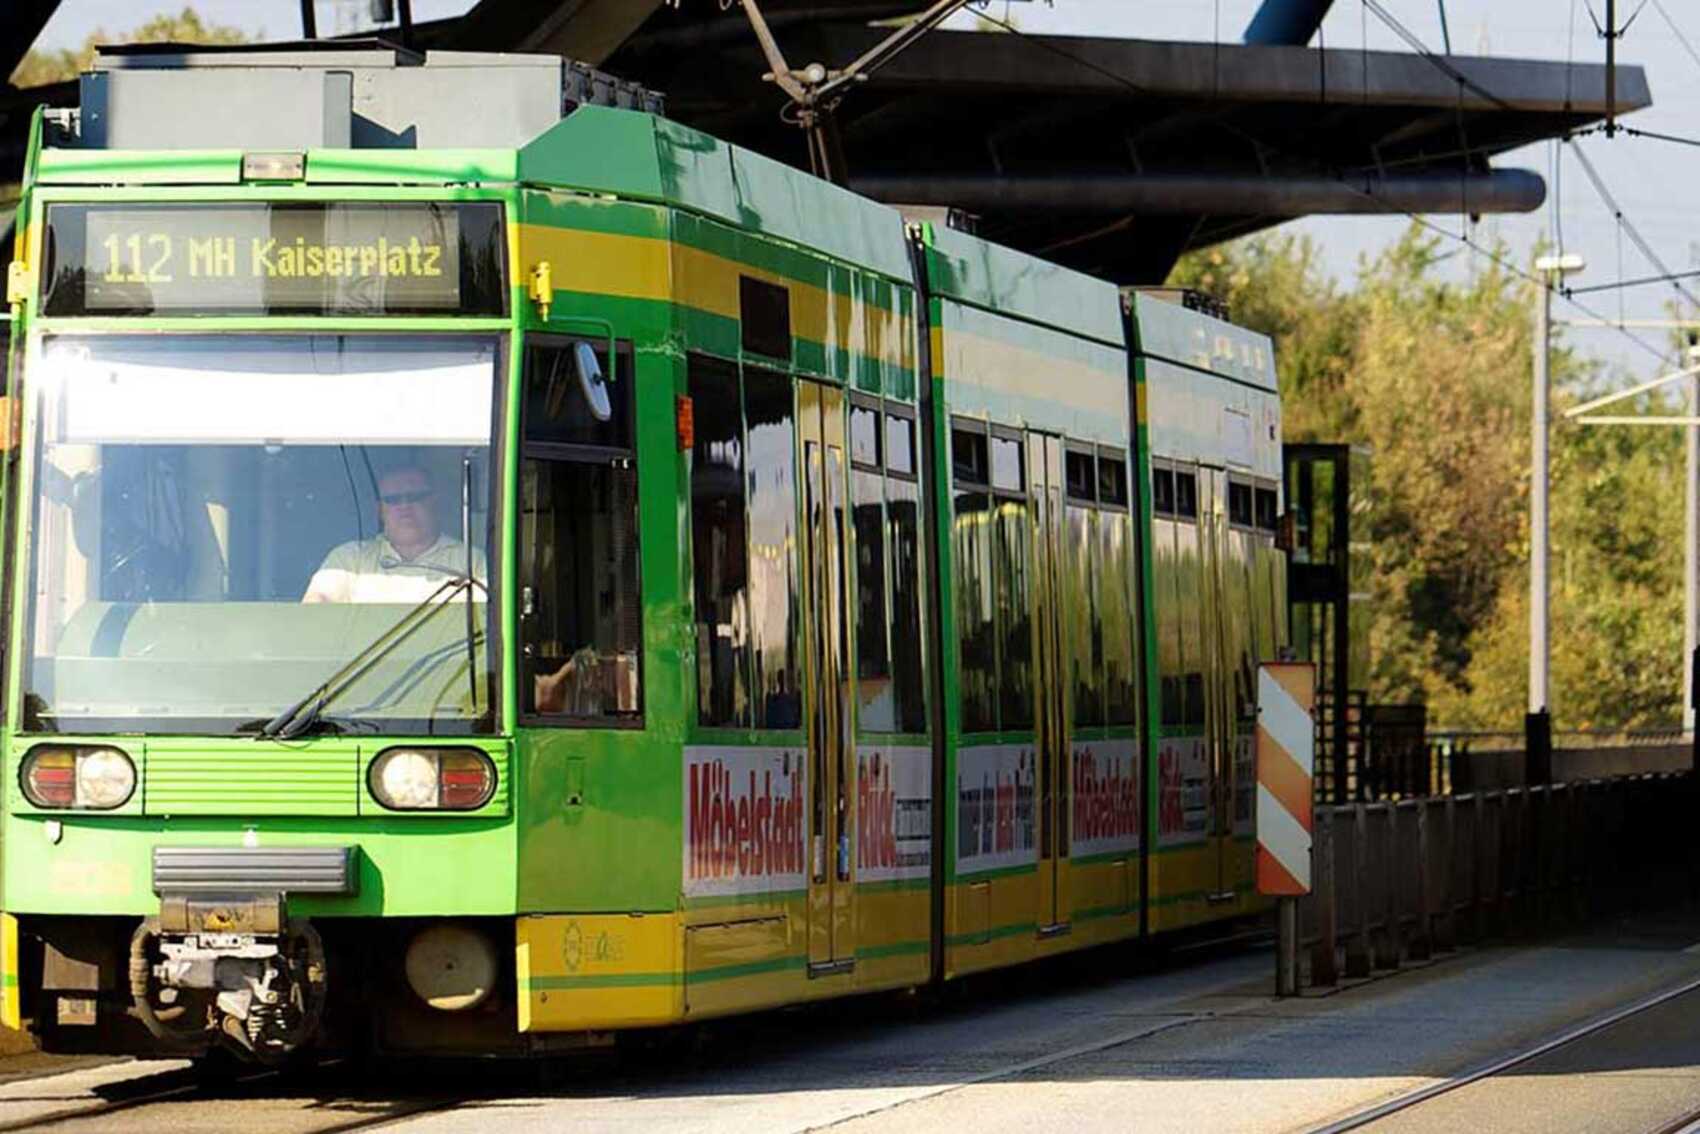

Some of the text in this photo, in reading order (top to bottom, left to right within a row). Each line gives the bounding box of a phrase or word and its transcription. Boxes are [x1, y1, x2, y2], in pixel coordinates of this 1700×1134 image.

[103, 233, 442, 283] 112 MH Kaiserplatz
